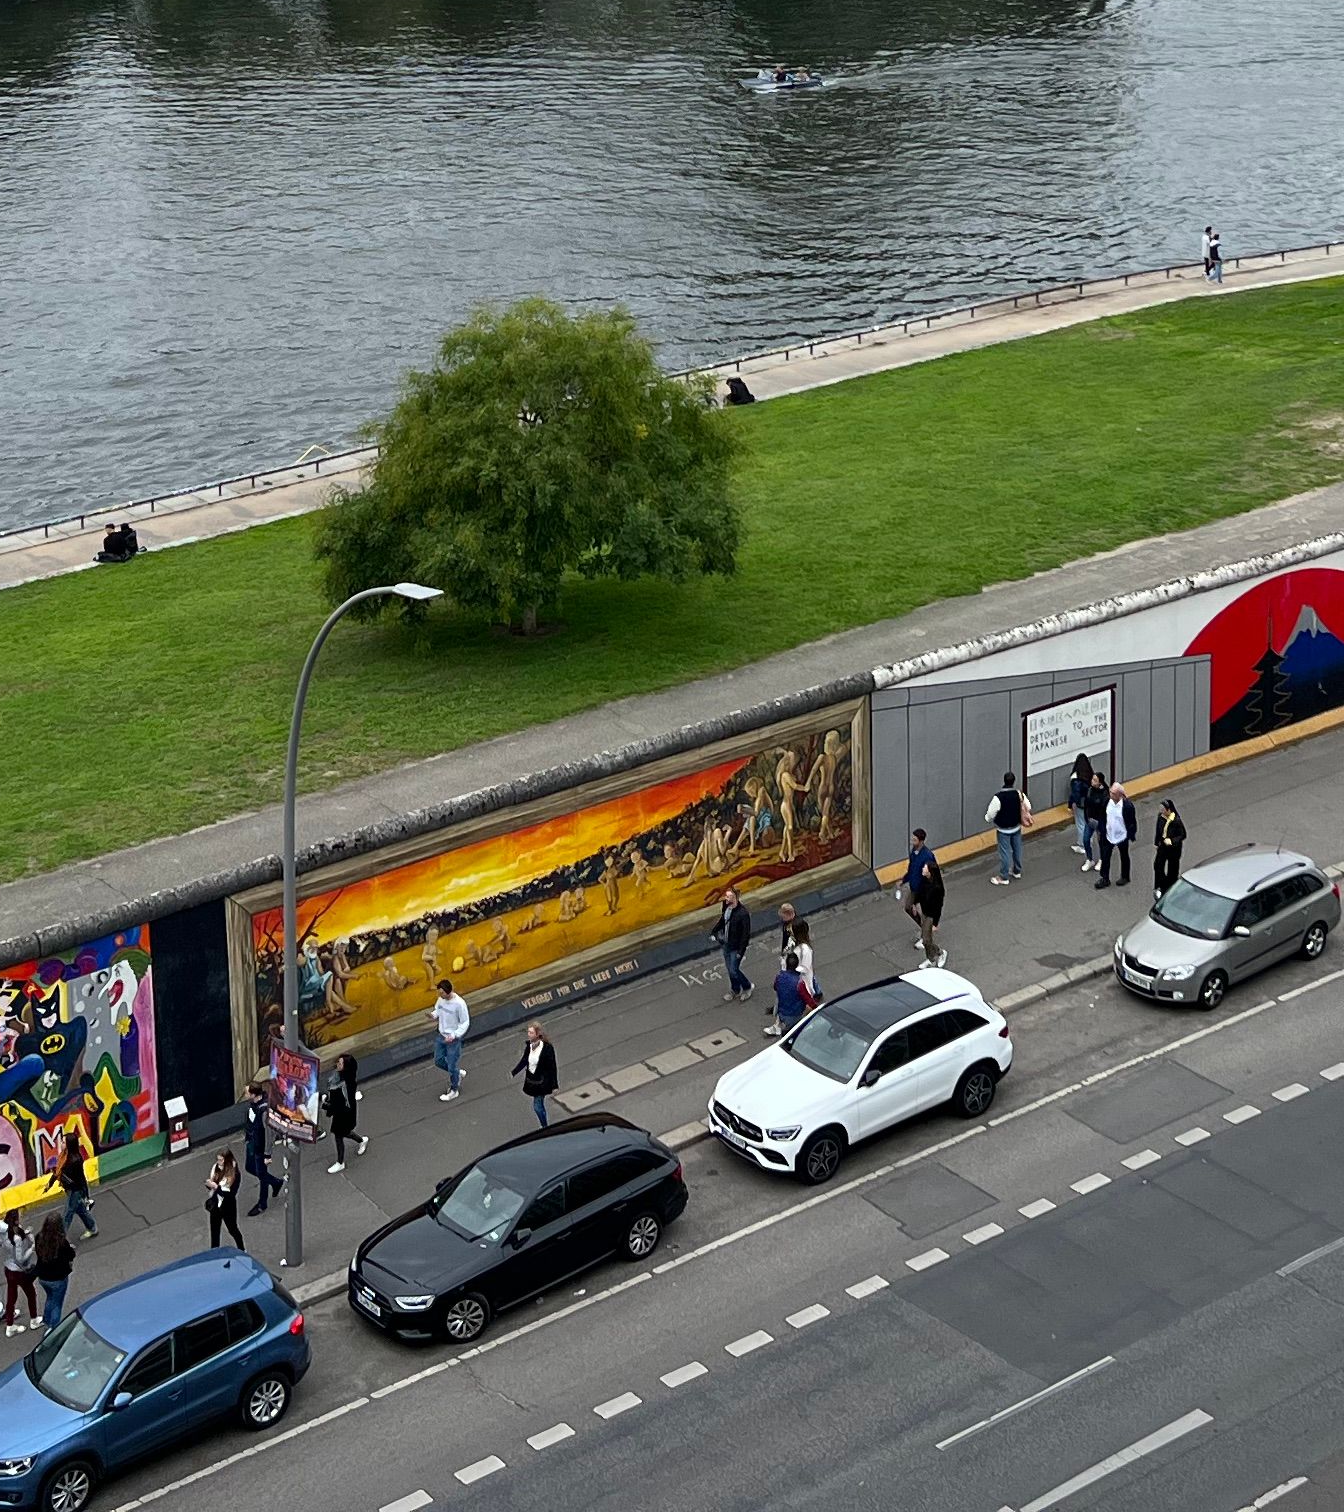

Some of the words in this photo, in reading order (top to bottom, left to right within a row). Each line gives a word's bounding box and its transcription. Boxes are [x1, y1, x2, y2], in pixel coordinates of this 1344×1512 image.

[1029, 727, 1060, 745] DETOUR
[1072, 720, 1083, 731] TO
[1094, 712, 1107, 723] THE
[1031, 735, 1068, 754] JAPANESE
[1081, 722, 1108, 738] SECTOR
